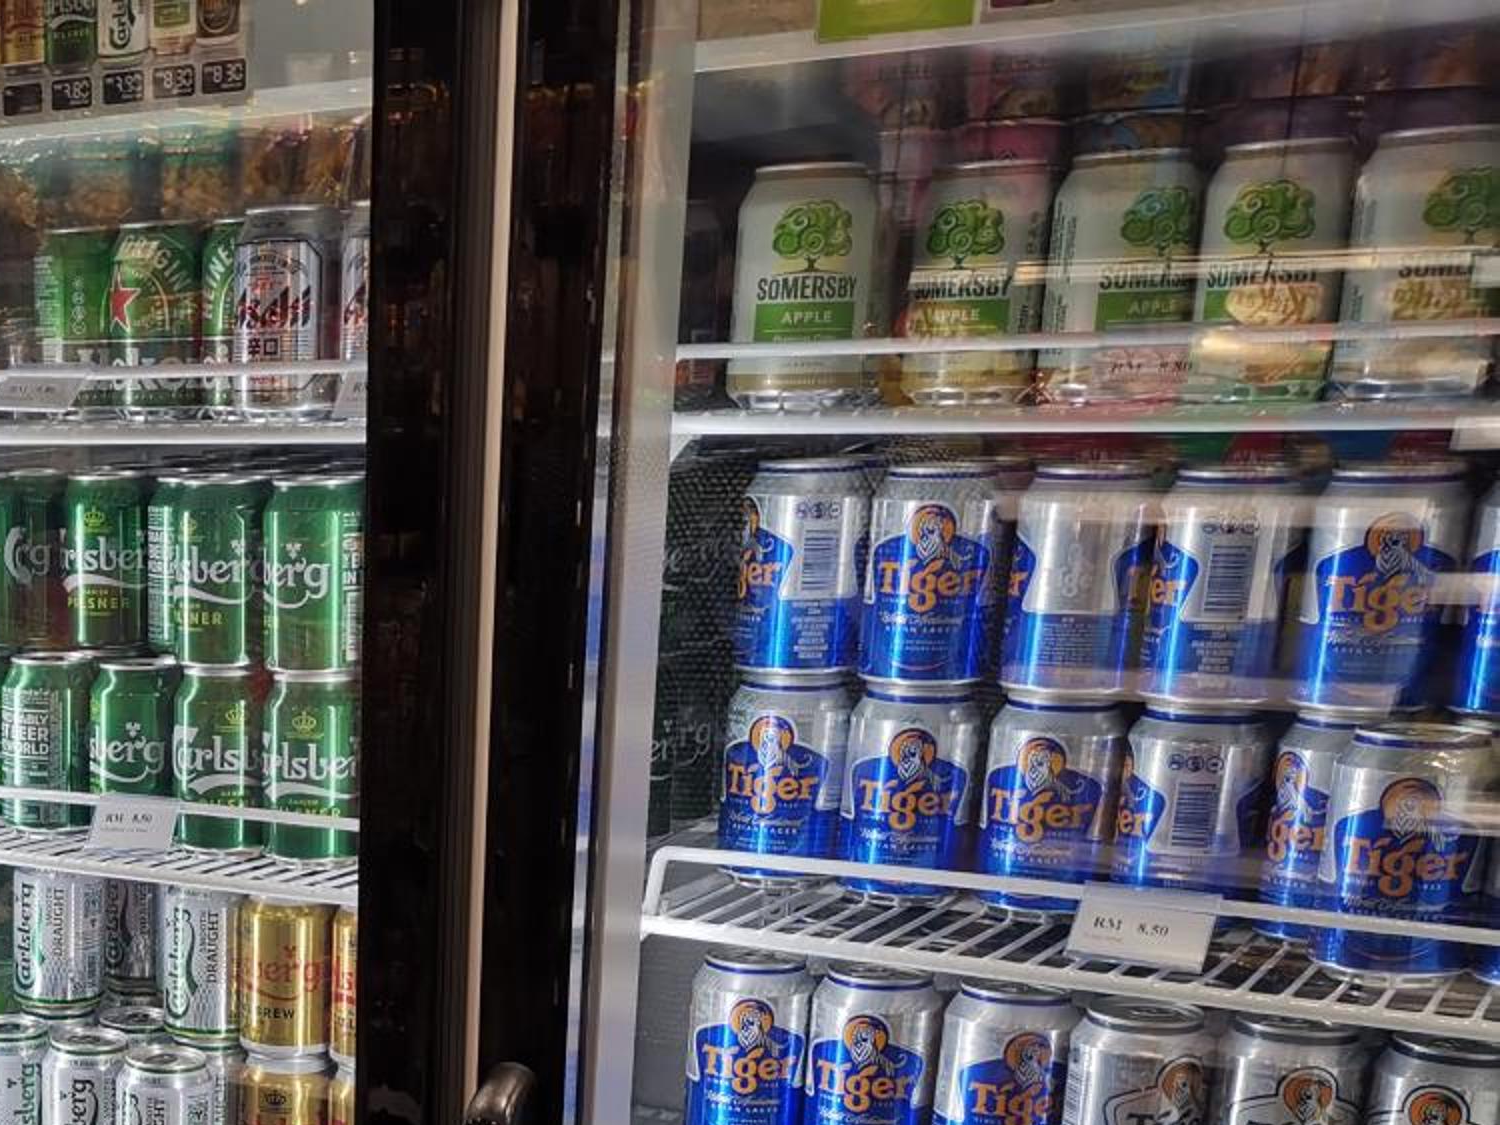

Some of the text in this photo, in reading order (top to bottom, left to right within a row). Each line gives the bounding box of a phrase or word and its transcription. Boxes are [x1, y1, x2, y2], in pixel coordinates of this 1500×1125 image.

[756, 275, 857, 301] SOMERSBY
[781, 310, 832, 327] APPLE
[876, 558, 985, 613] Tiger
[1326, 573, 1427, 633] Tige
[727, 761, 820, 814] Tiger
[859, 778, 951, 829] Tiger
[991, 788, 1094, 843] Tiger
[1346, 835, 1463, 897] Tiger
[14, 882, 36, 990] Carlsberg
[53, 888, 65, 957] DRAUGHT
[206, 911, 219, 984] DRAUGHT
[1093, 914, 1170, 938] RM 8.50
[701, 1042, 796, 1094] Tiger
[816, 1058, 911, 1114] Tiger
